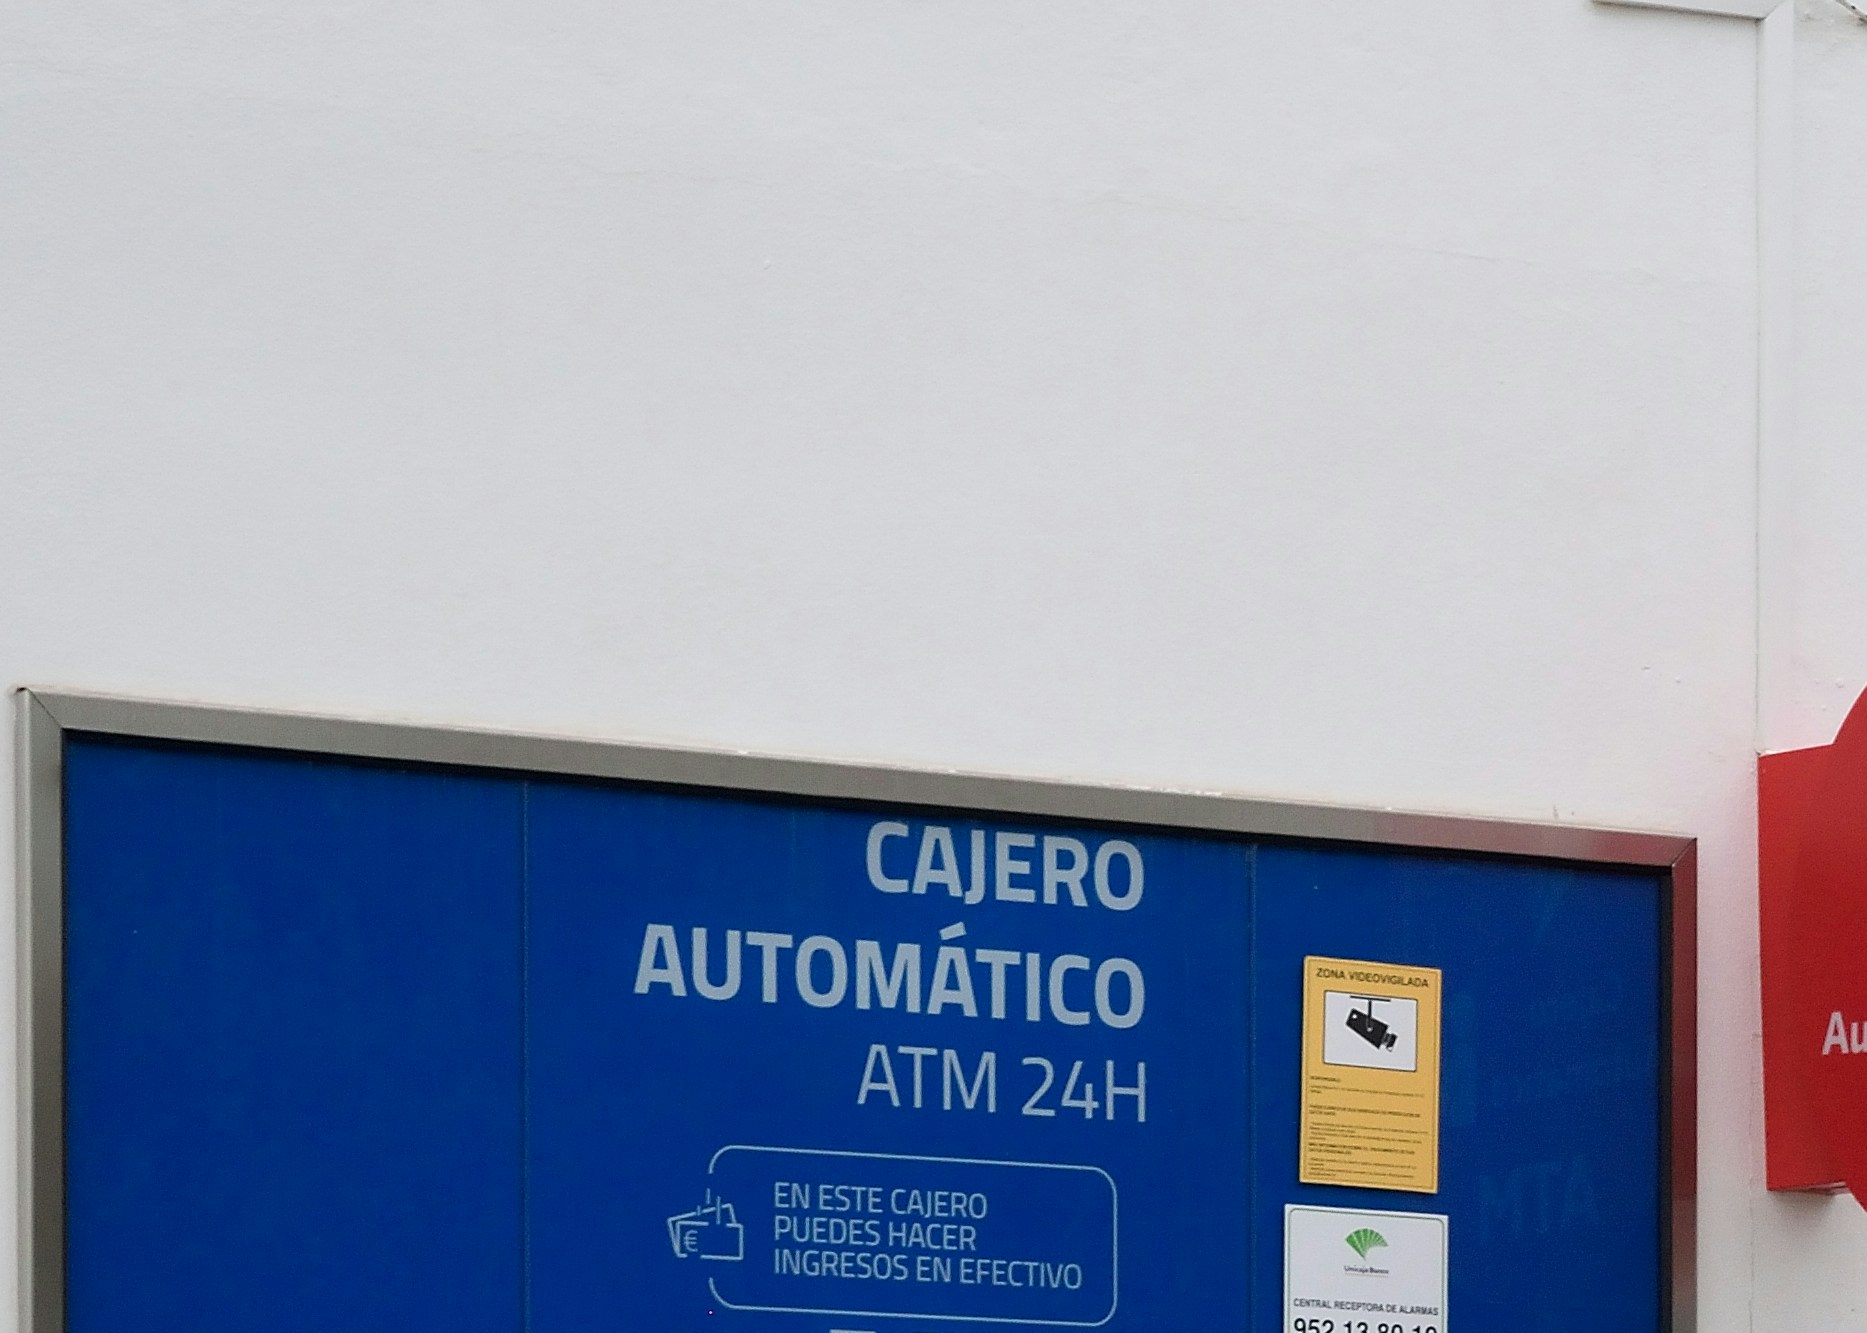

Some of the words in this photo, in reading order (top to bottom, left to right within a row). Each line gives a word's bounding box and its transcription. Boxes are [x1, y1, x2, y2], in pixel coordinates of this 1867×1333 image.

[866, 822, 1144, 911] CAJERO
[634, 922, 1144, 1029] AUTOMÁTICO
[1316, 967, 1345, 981] ZONA
[1349, 971, 1429, 988] VIDEOVIGILADA
[857, 1044, 996, 1113] ATM
[1021, 1056, 1146, 1123] 24H
[774, 1182, 810, 1209] EN
[817, 1185, 882, 1213] ESTE
[890, 1188, 988, 1220] CAJERO
[774, 1216, 881, 1248] PUEDES
[888, 1221, 976, 1252] HACER
[774, 1249, 909, 1281] INGRESOS
[916, 1256, 951, 1283] EN
[959, 1259, 1082, 1290] EFECTIVO
[1293, 1298, 1332, 1310] CENTRAL
[1334, 1300, 1384, 1313] RECEPTORA
[1386, 1303, 1398, 1313] DE
[1399, 1304, 1439, 1316] ALARMAS
